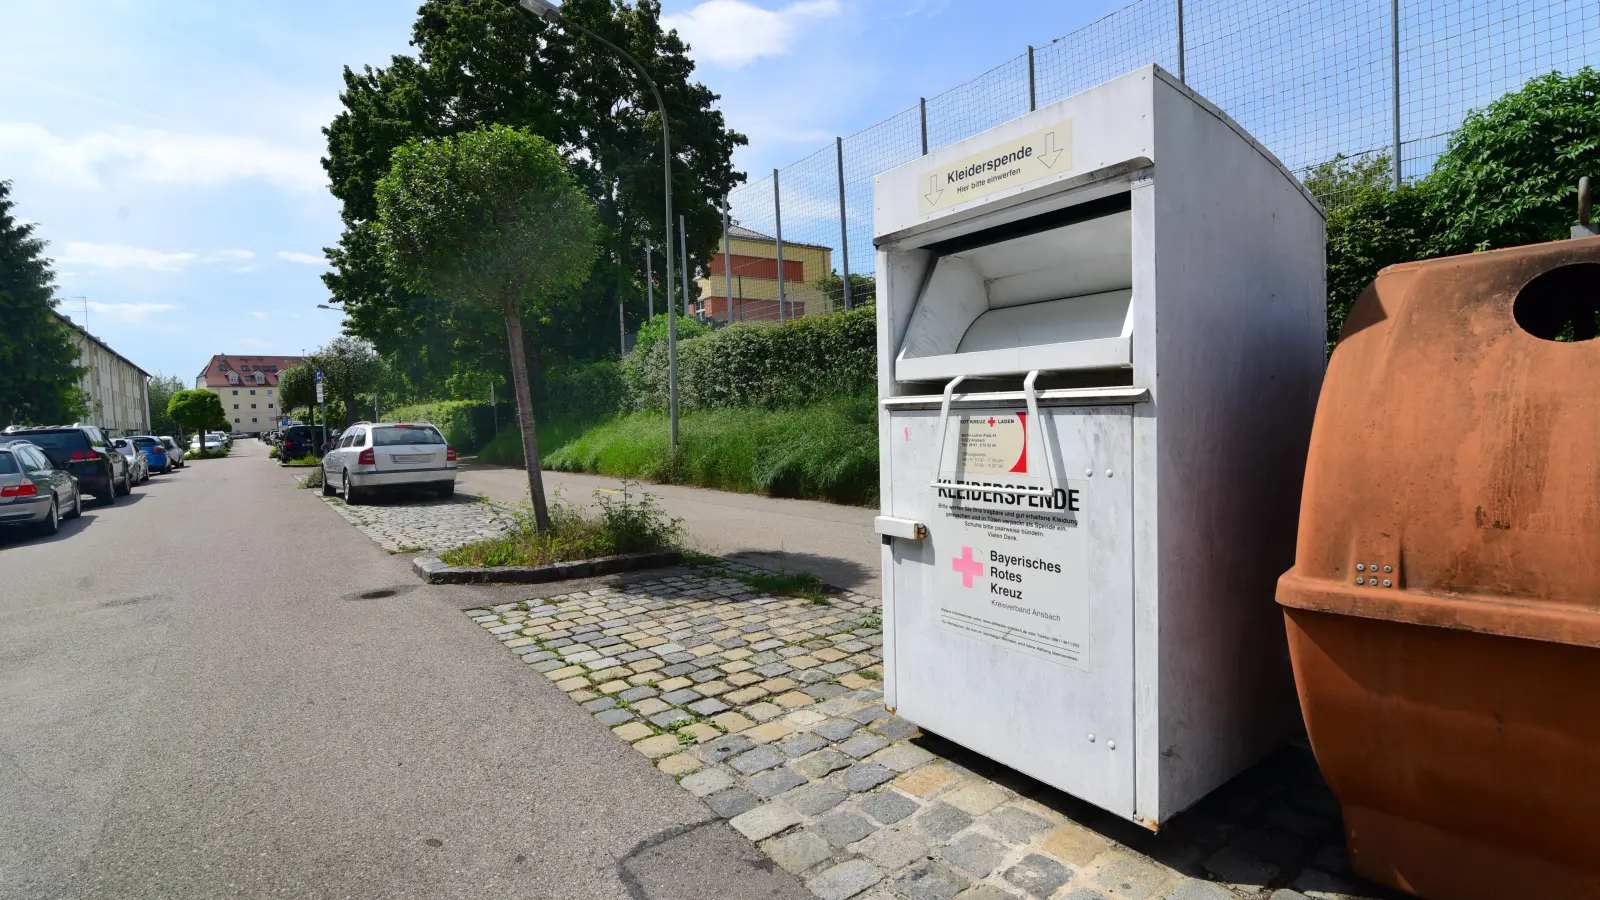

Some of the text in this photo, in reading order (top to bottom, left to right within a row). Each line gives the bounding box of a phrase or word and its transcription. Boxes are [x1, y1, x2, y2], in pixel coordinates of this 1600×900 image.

[947, 146, 1032, 184] Kleiderspende
[956, 167, 1021, 194] Hier bitte einwerfen
[938, 478, 1080, 511] KLEIDERSPENDE
[983, 508, 1004, 516] tragbare
[1026, 514, 1050, 522] erhaltene
[1052, 516, 1078, 526] Kleidung
[988, 531, 1003, 539] Vielen
[995, 526, 1021, 534] paarweise
[1021, 529, 1044, 537] bündeln.
[1035, 522, 1056, 531] Spende
[990, 550, 1061, 574] Bayerisches
[990, 566, 1022, 583] Rotes
[990, 582, 1023, 600] Kreuz
[991, 600, 1061, 621] Kreisverband Ansbach
